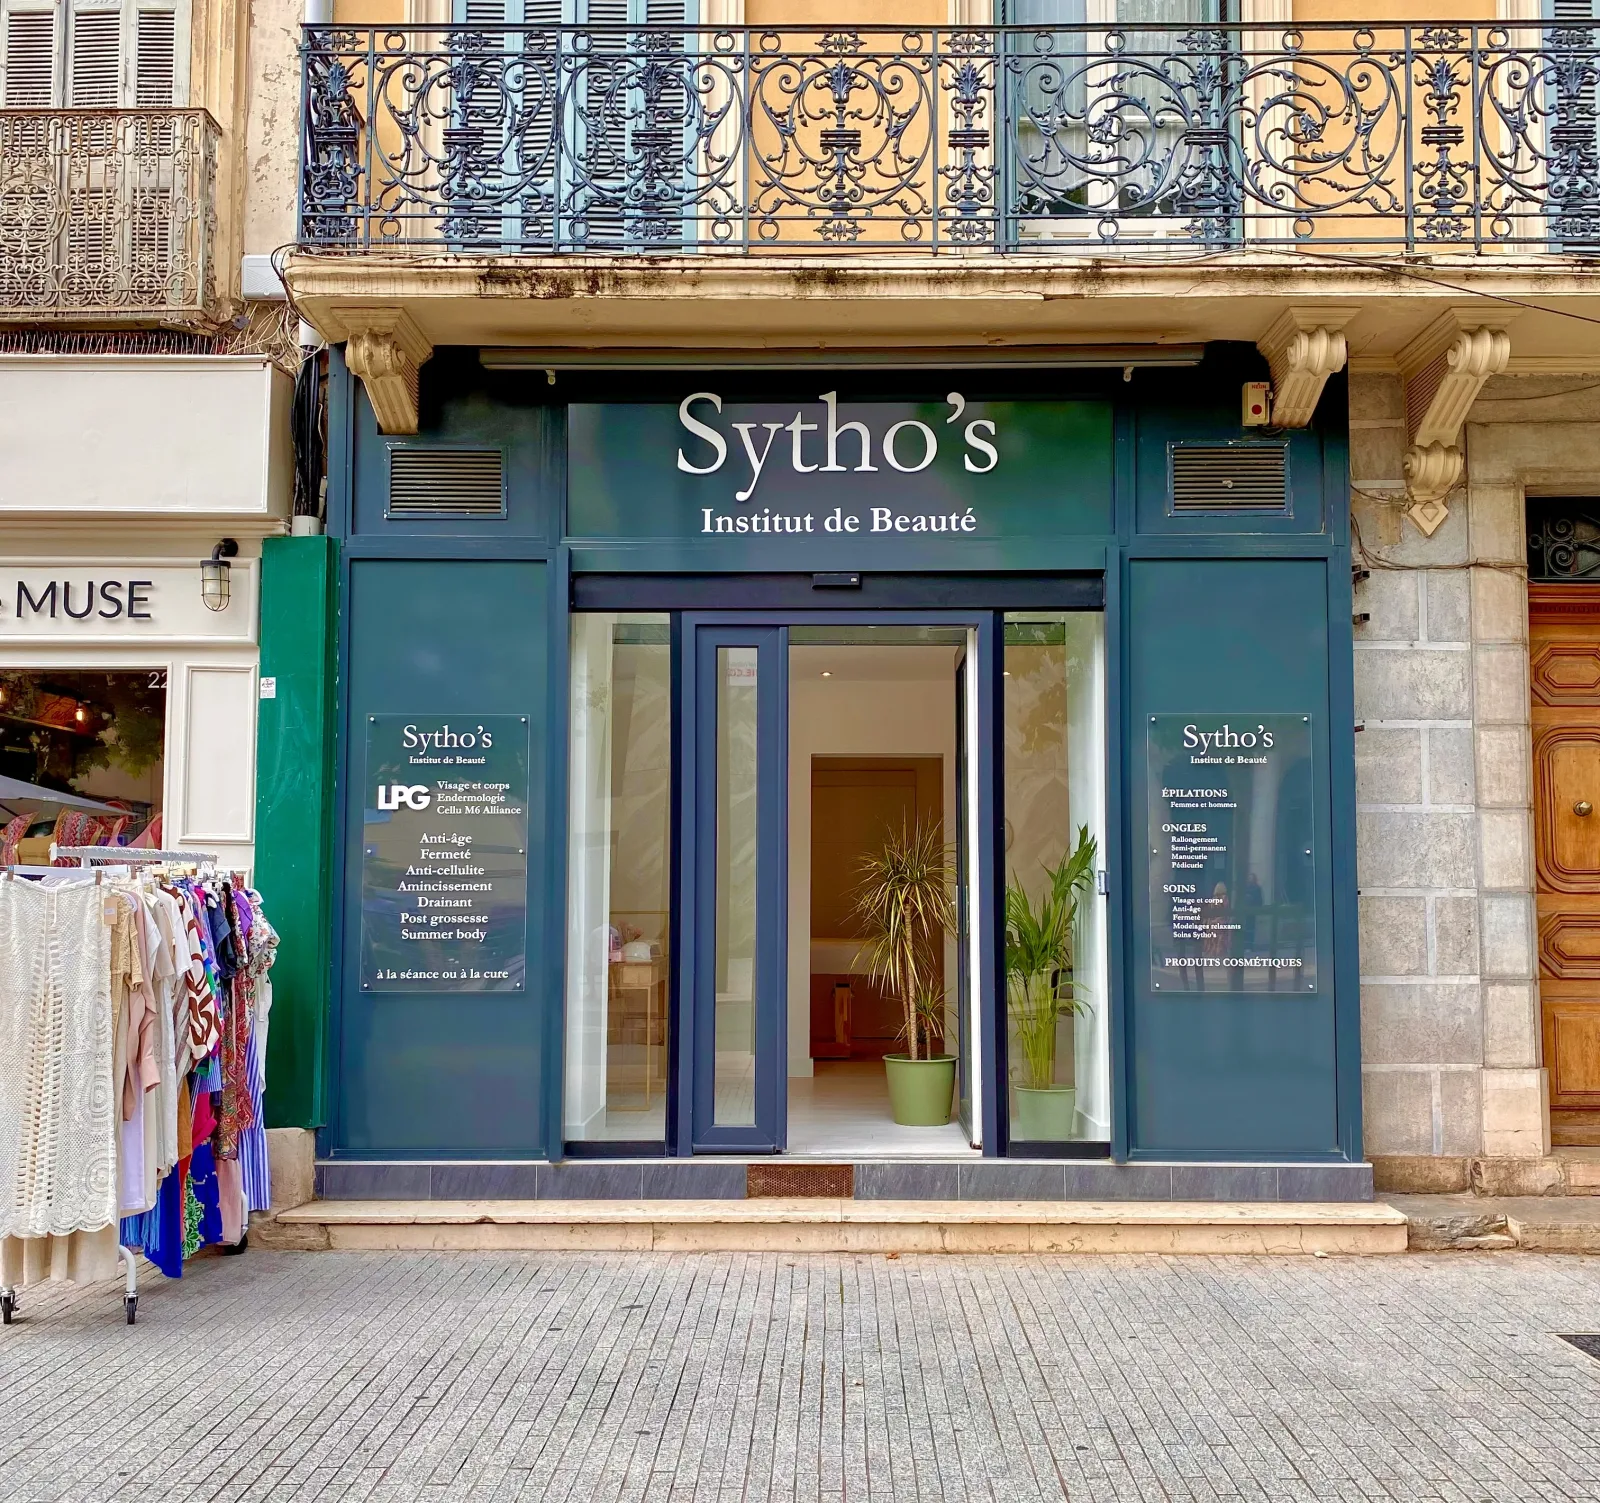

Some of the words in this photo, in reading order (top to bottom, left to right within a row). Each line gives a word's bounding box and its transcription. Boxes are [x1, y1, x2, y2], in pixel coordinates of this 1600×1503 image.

[677, 391, 999, 502] Sytho's
[701, 508, 814, 532] Institut
[824, 508, 859, 532] de
[870, 508, 977, 532] Beauté
[16, 580, 152, 618] MUSE
[403, 724, 492, 755] Sytho's
[1183, 724, 1273, 755] Sytho's
[409, 756, 441, 764] Institut
[444, 756, 454, 764] de
[456, 756, 485, 764] Beauté
[1190, 756, 1222, 764] Institut
[1224, 756, 1235, 764] de
[1237, 756, 1267, 764] Beauté
[437, 781, 470, 792] Visage
[472, 781, 481, 790] et
[484, 781, 510, 791] corps
[1162, 787, 1227, 797] ÉPILATIONS
[378, 785, 430, 810] LPG
[437, 794, 506, 803] Endermologie
[437, 805, 462, 814] Cellu
[465, 805, 481, 814] M6
[483, 805, 521, 814] Alliance
[1162, 824, 1207, 832] ONGLES
[420, 833, 472, 847] Anti-âge
[1171, 836, 1218, 844] Rallongement
[1171, 845, 1226, 853] Semi-permanent
[420, 849, 471, 860] Fermeté
[406, 865, 485, 875] Anti-cellulite
[398, 881, 492, 892] Amincissement
[1163, 885, 1196, 893] SOINS
[417, 897, 472, 907] Drainant
[1172, 897, 1195, 905] Visage
[1205, 898, 1223, 906] corps
[1173, 906, 1201, 914] Anti-âge
[400, 913, 427, 924] Post
[430, 916, 488, 927] grossesse
[1173, 913, 1200, 921] Fermeté
[1173, 923, 1209, 931] Modelages
[1211, 922, 1241, 930] relaxants
[401, 929, 453, 940] Summer
[456, 929, 486, 942] body
[1173, 931, 1191, 939] Soins
[1193, 932, 1216, 940] Sytho's
[1165, 957, 1220, 967] PRODUITS
[1223, 956, 1302, 968] COSMÉTIQUES
[376, 970, 384, 979] à
[387, 969, 397, 979] la
[400, 969, 439, 979] séance
[442, 971, 457, 979] ou
[460, 969, 467, 979] à
[470, 969, 480, 979] la
[483, 970, 508, 979] cure
